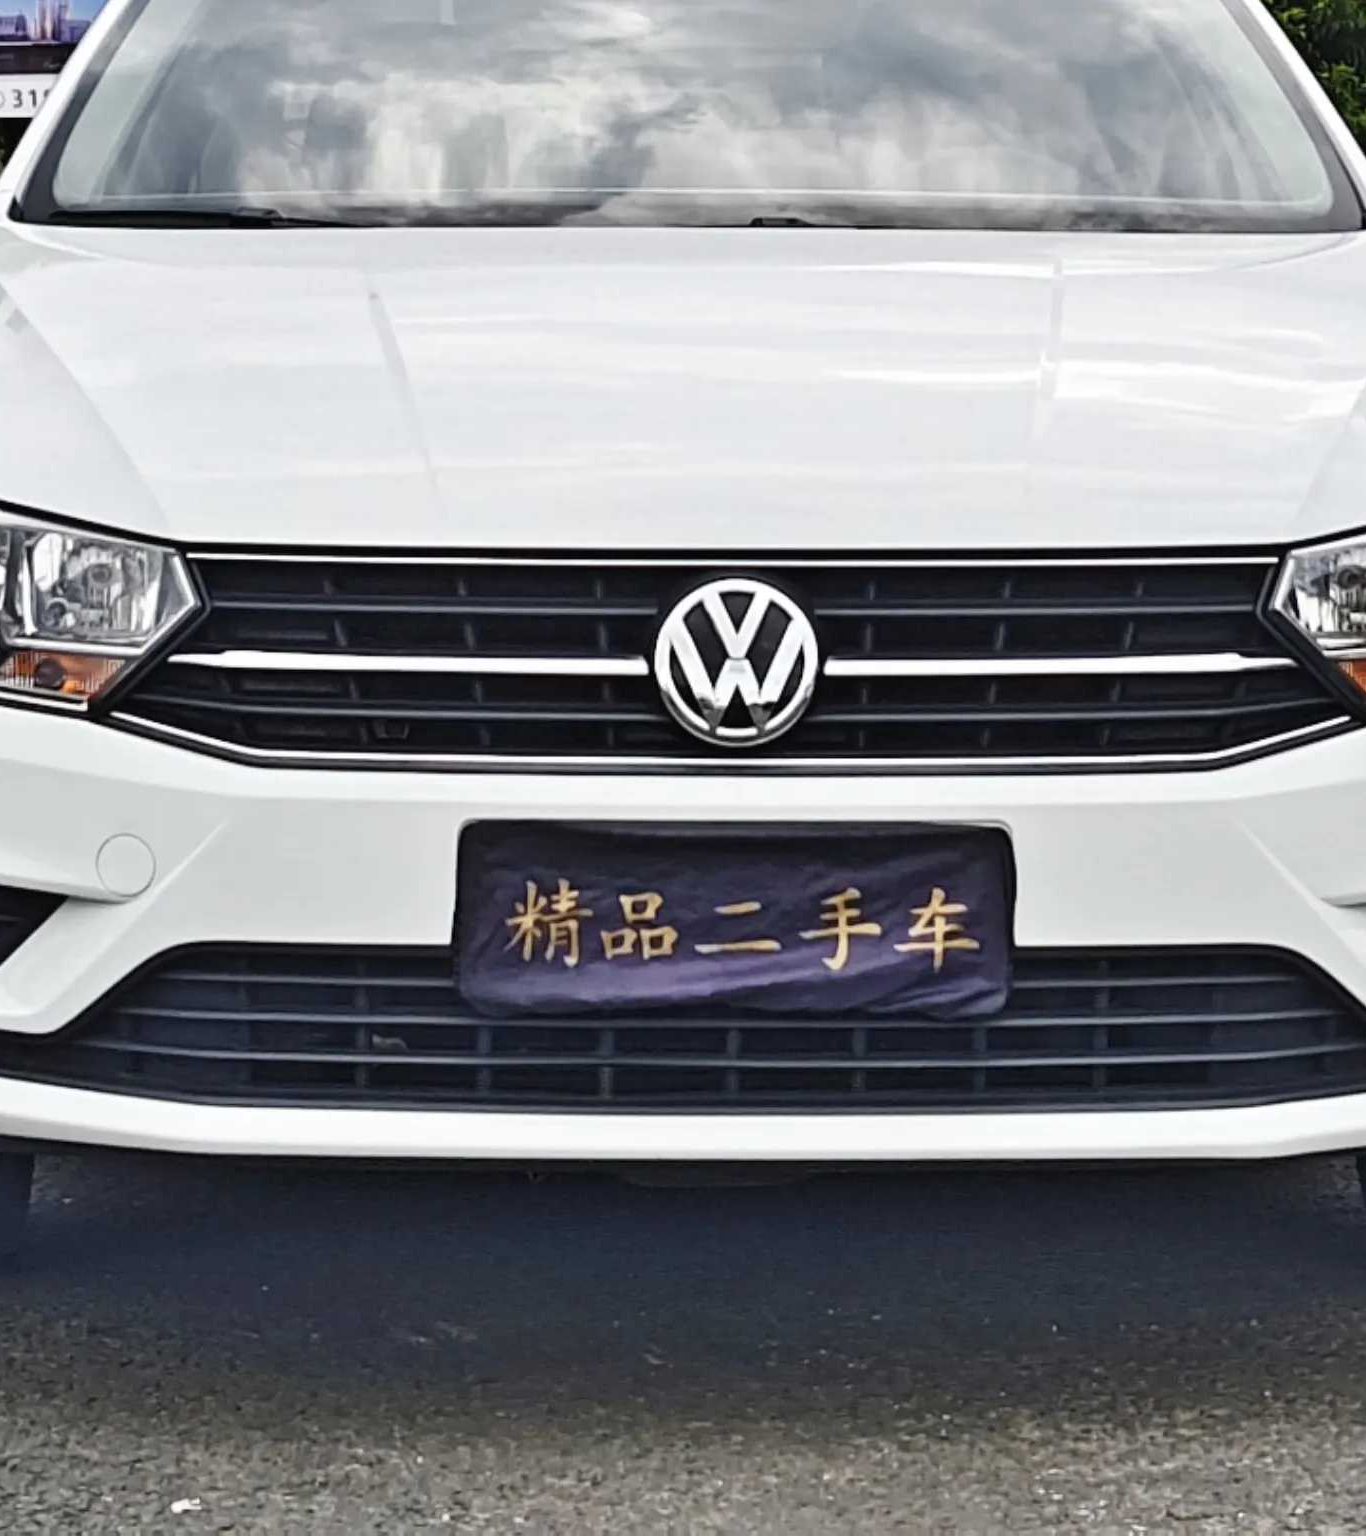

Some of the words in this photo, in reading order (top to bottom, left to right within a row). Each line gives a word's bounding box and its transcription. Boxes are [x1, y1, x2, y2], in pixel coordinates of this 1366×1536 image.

[11, 88, 51, 109] 31
[505, 878, 981, 972] 精品二手车
